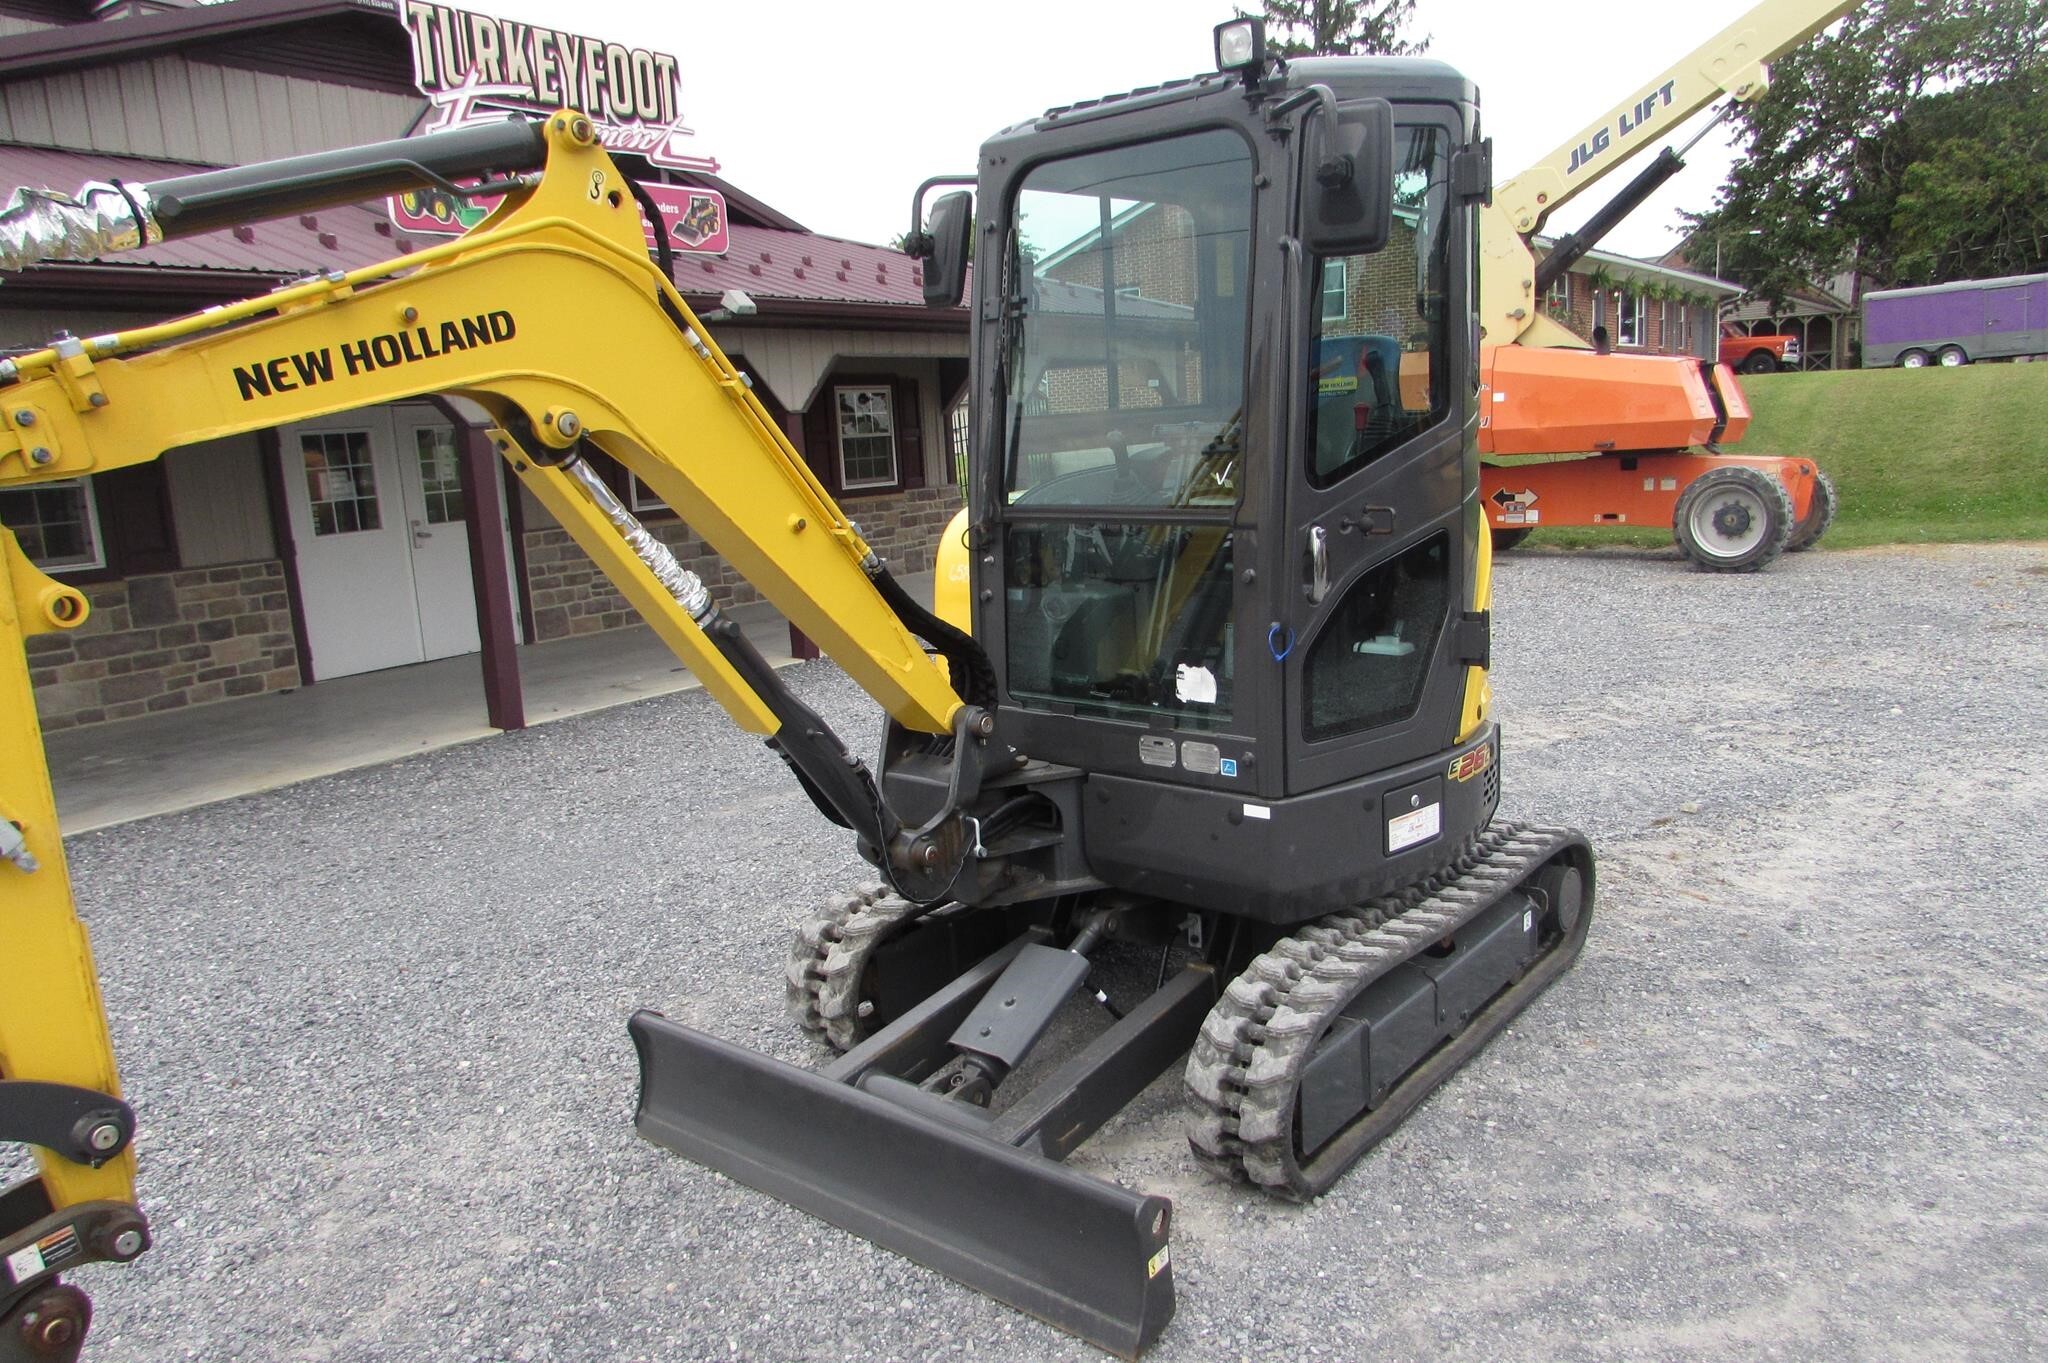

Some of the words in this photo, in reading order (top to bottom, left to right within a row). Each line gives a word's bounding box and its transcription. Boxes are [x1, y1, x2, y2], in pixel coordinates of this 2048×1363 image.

[407, 0, 682, 124] TURKEYFOOT
[1567, 126, 1610, 175] JLG
[1618, 79, 1675, 137] LIFT
[232, 347, 334, 401] NEW
[340, 310, 516, 376] HOLLAND
